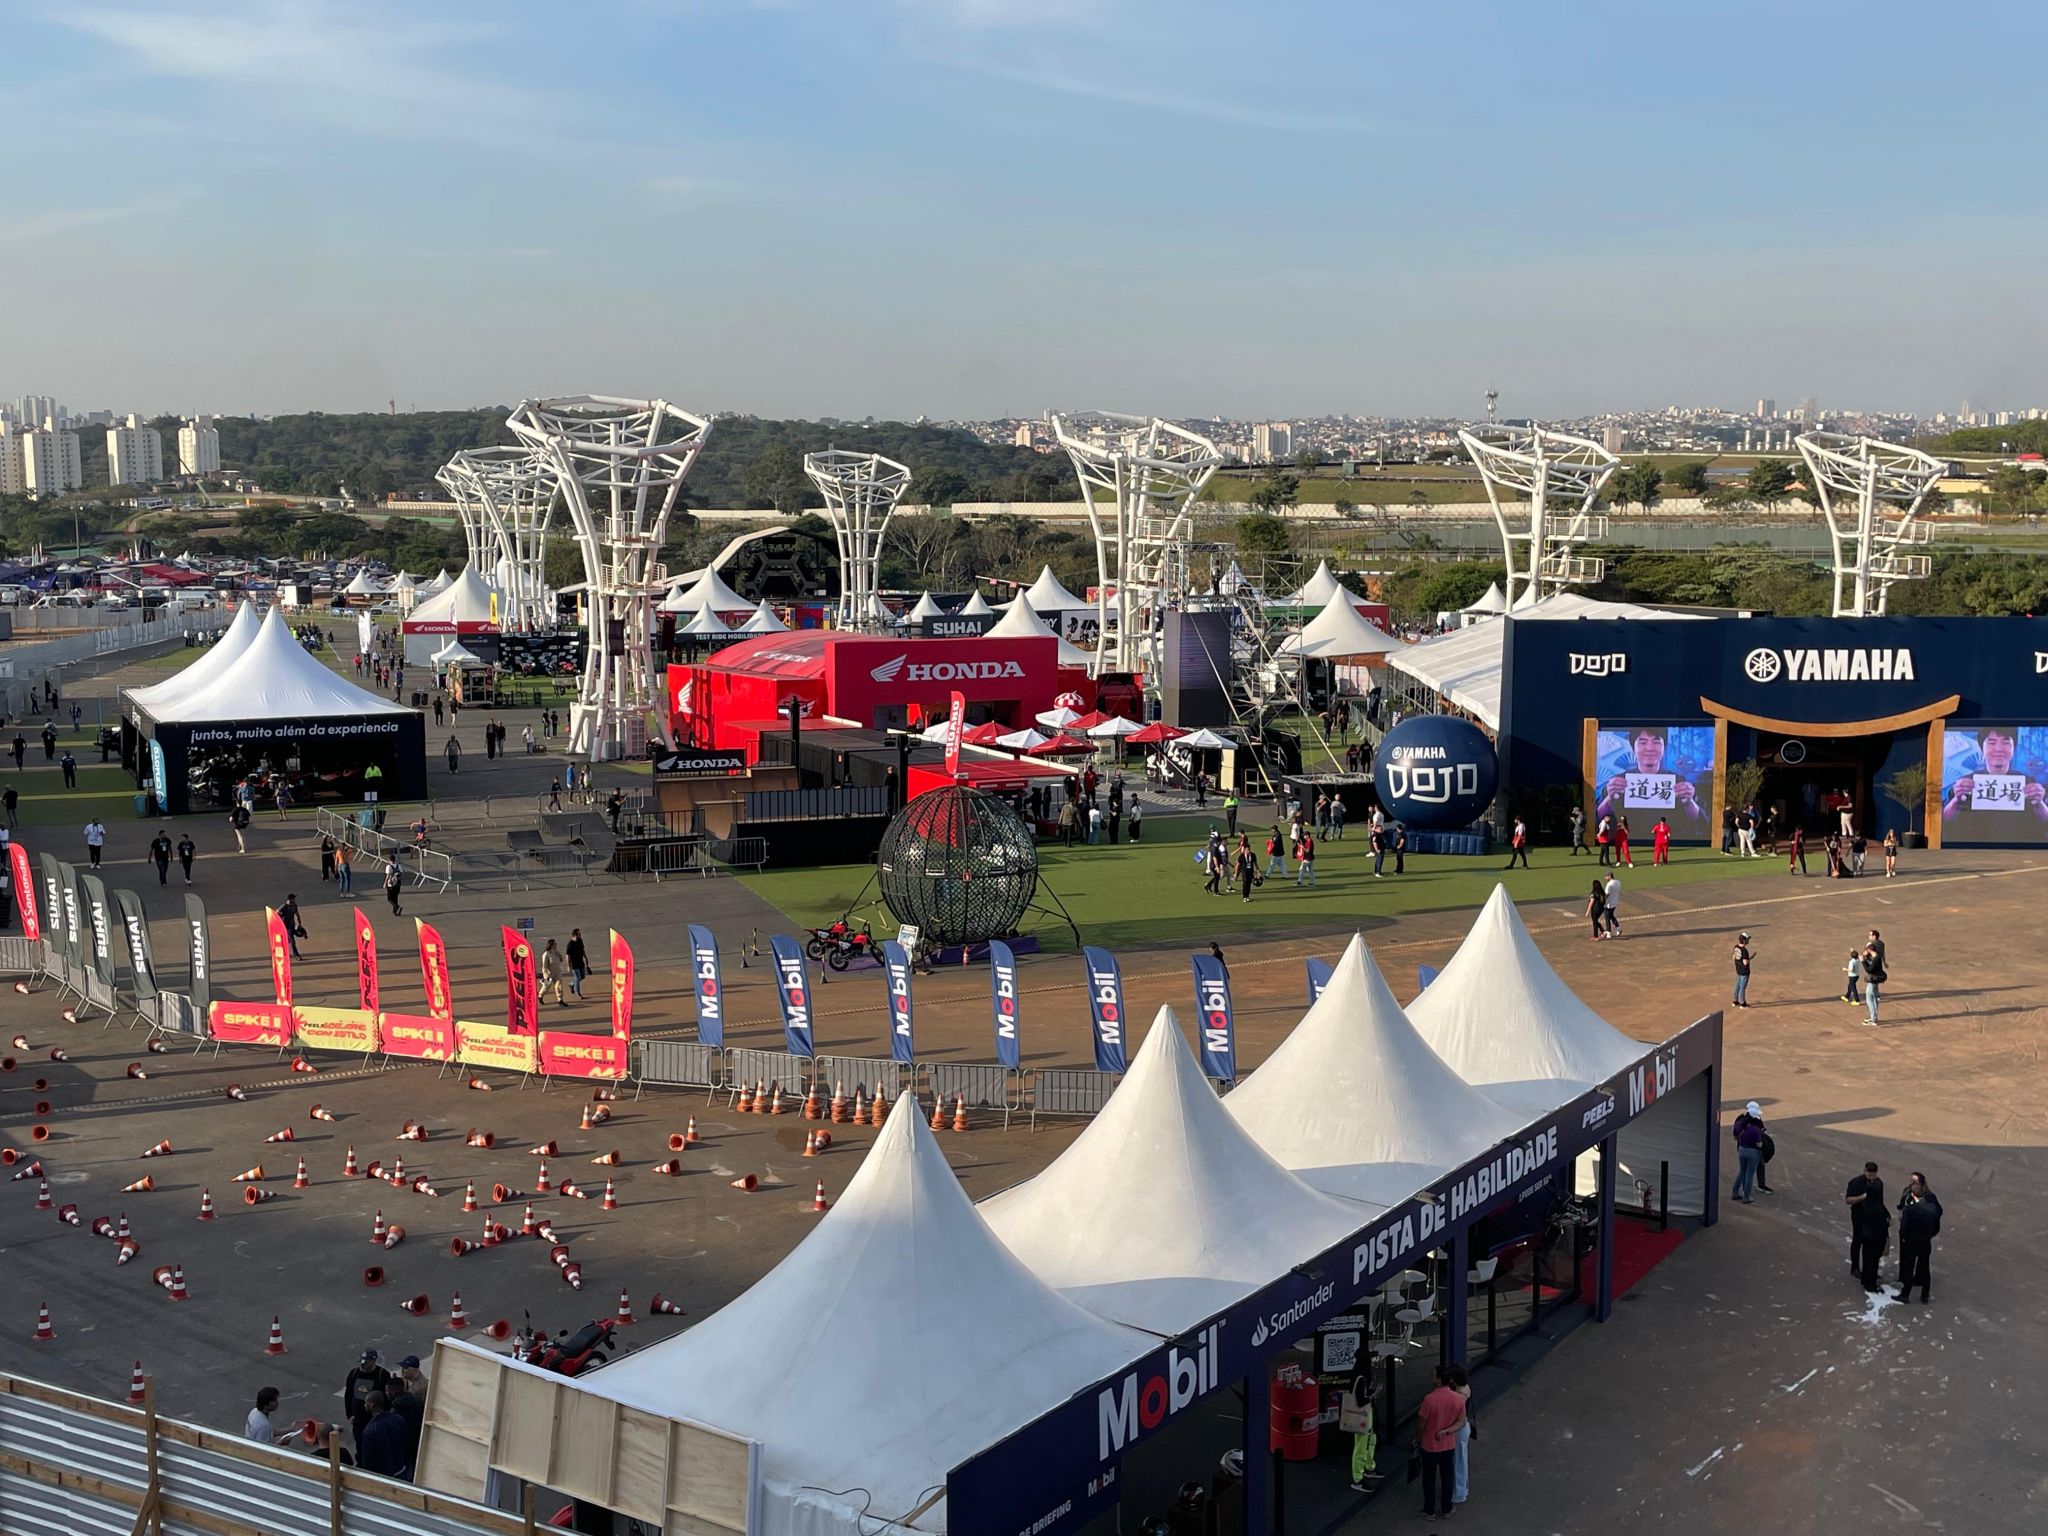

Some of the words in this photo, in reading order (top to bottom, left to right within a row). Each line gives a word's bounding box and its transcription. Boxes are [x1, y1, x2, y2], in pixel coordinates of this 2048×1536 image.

[932, 621, 982, 635] SUHAI
[906, 661, 1026, 681] HONDA
[1569, 652, 1626, 677] DOJO
[1783, 648, 1915, 681] YAMAHA
[190, 729, 233, 744] juntos,
[236, 725, 272, 738] muito
[275, 724, 306, 737] além
[308, 724, 325, 735] da
[327, 722, 399, 737] experiencia
[1402, 746, 1446, 759] YAMAHA
[676, 758, 743, 769] HONDA
[1385, 763, 1478, 803] DOJO
[1628, 778, 1673, 800] 道場
[1976, 779, 2022, 801] 道場
[18, 854, 34, 917] Santander
[46, 878, 60, 930] SUHAI
[63, 888, 78, 943] SUHAI
[92, 901, 108, 958] SUHAI
[127, 915, 146, 973] SUHAI
[191, 921, 204, 979] SUHAI
[696, 949, 719, 1018] Mobil
[780, 958, 808, 1028] Mobil
[892, 964, 910, 1037] Mobil
[996, 966, 1015, 1039] Mobil
[223, 1013, 270, 1027] SPIKE
[1093, 972, 1121, 1045] Mobil
[1201, 980, 1229, 1052] Mobil
[392, 1026, 433, 1041] SPIKE
[552, 1045, 603, 1060] SPIKE
[1628, 1046, 1676, 1117] Mobil
[1581, 1095, 1616, 1129] PEELS
[1353, 1214, 1415, 1286] PISTA
[1419, 1193, 1446, 1242] DE
[1450, 1125, 1558, 1221] HABILIDADE
[1270, 1281, 1336, 1337] Santander
[1098, 1323, 1219, 1462] Mobil
[1087, 1467, 1115, 1498] Mobil
[1032, 1499, 1072, 1536] BRIEFING
